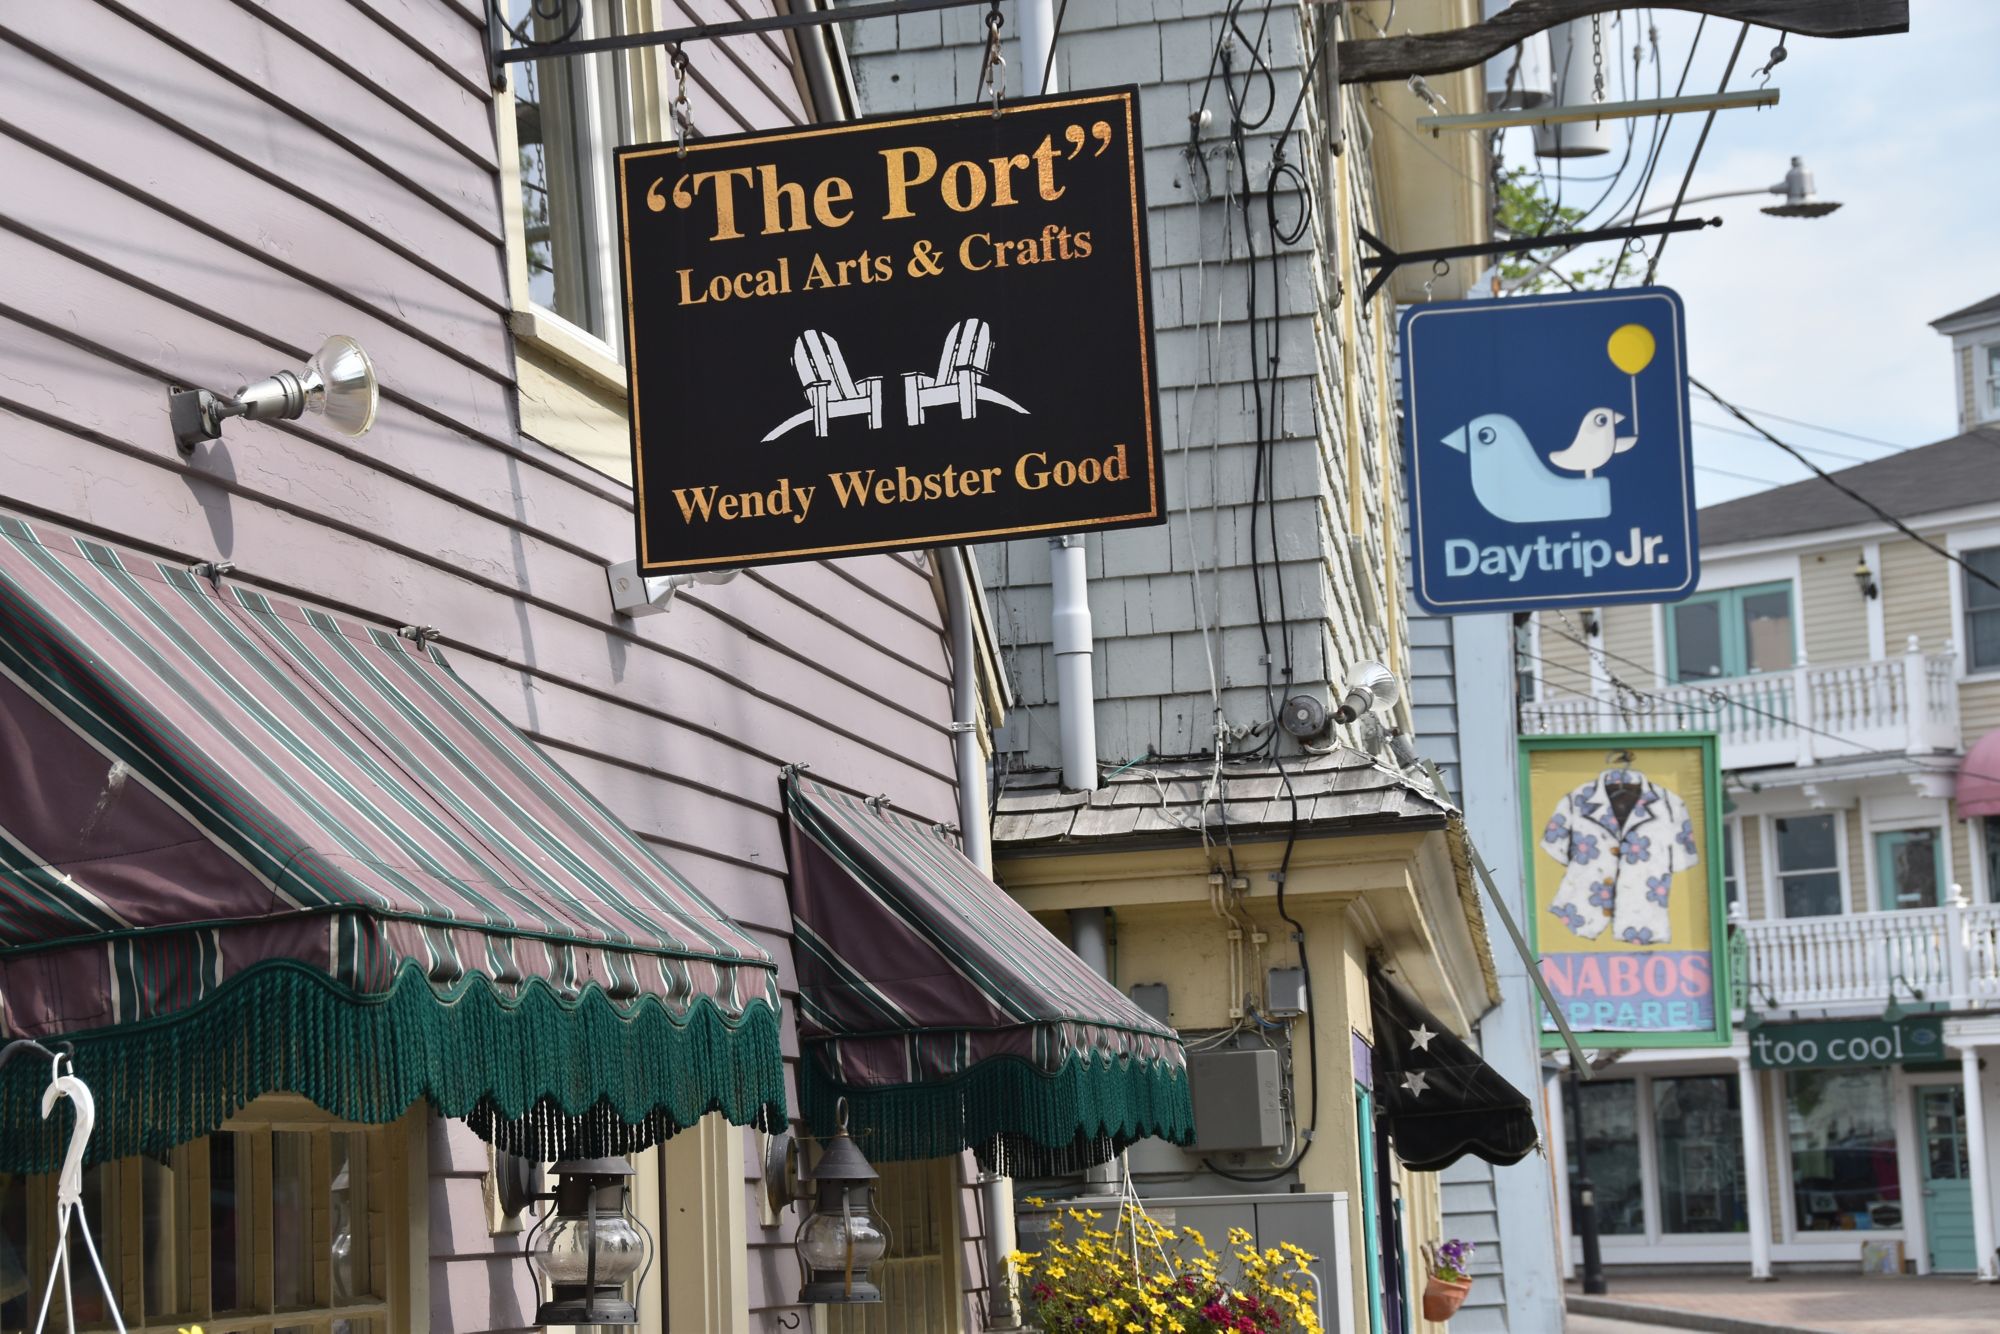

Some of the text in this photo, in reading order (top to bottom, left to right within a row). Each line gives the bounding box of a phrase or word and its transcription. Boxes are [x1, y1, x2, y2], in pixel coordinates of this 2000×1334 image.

[676, 224, 1093, 307] Local Arts & Crafts
[672, 444, 1130, 525] Wendy Webster Good
[1542, 955, 1711, 998] NABOS
[1545, 1000, 1713, 1028] PPAREL
[1752, 1025, 1903, 1065] too cool
